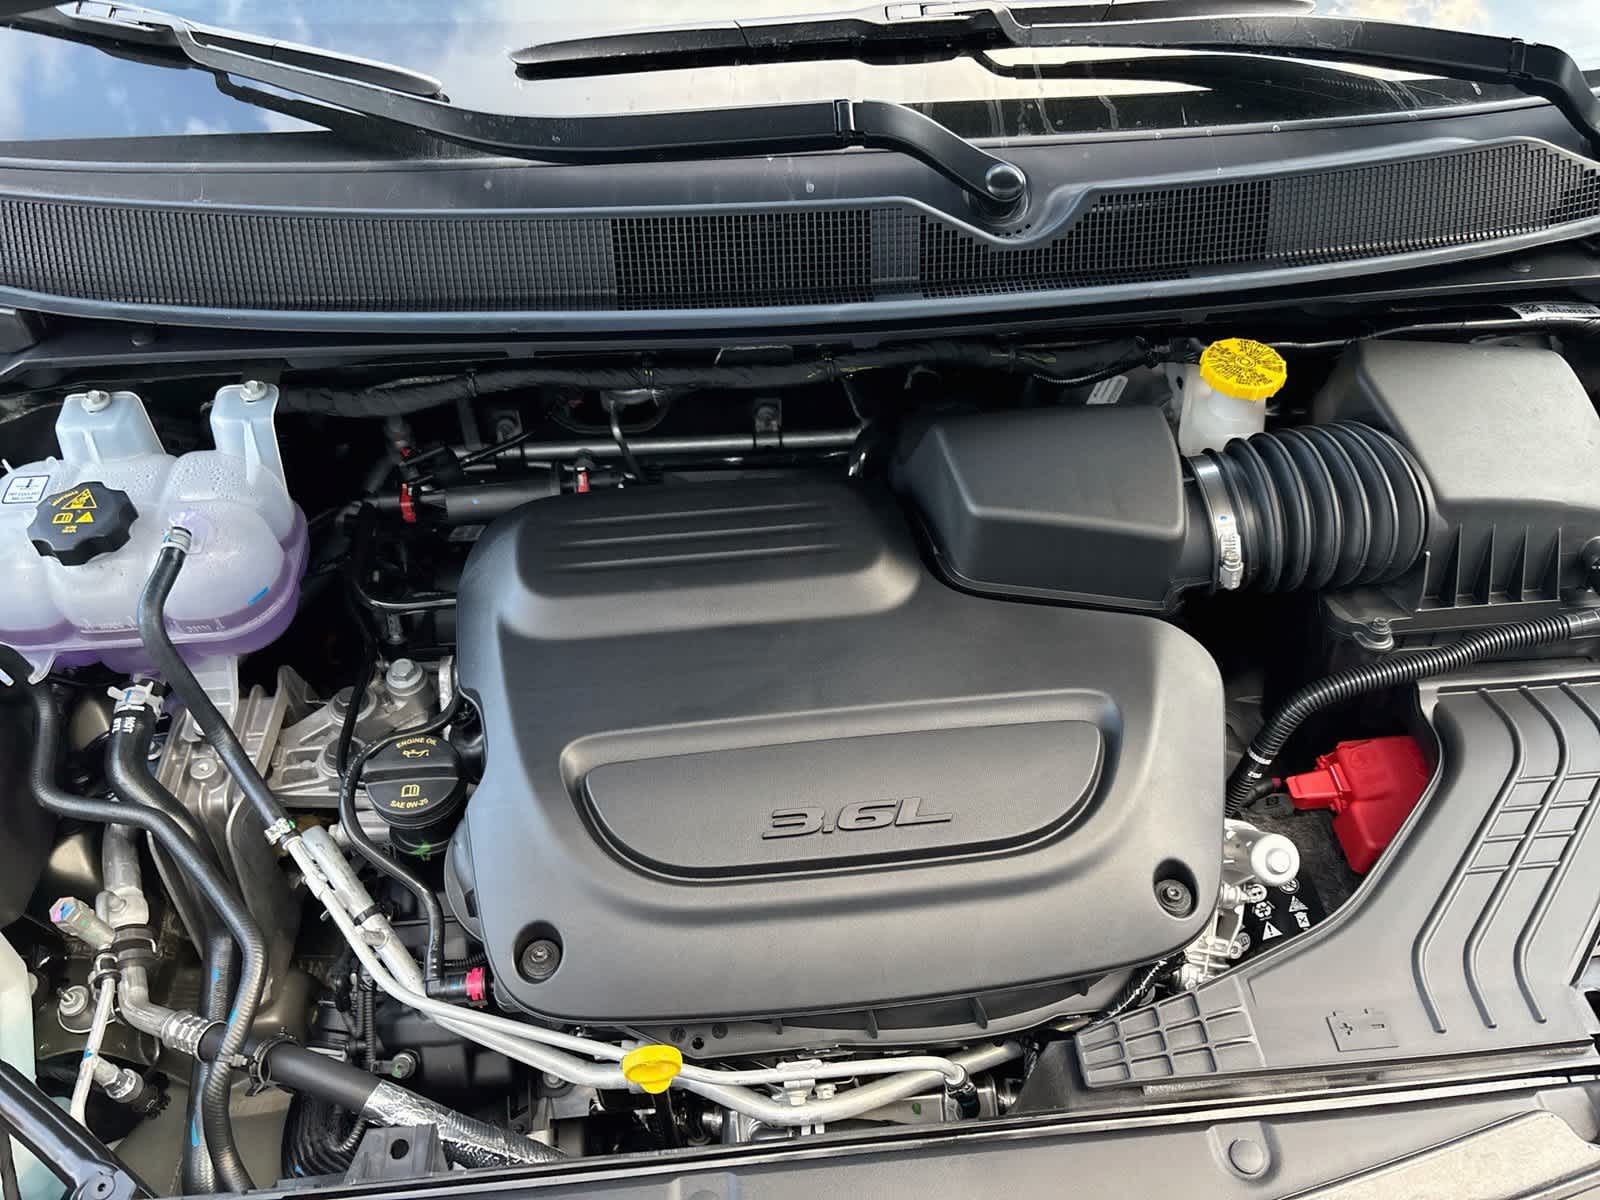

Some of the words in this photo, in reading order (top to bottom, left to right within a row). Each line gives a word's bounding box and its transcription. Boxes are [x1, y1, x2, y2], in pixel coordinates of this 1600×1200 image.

[396, 737, 425, 748] ENGINE
[390, 800, 406, 808] SAE
[762, 797, 953, 840] 3.6L
